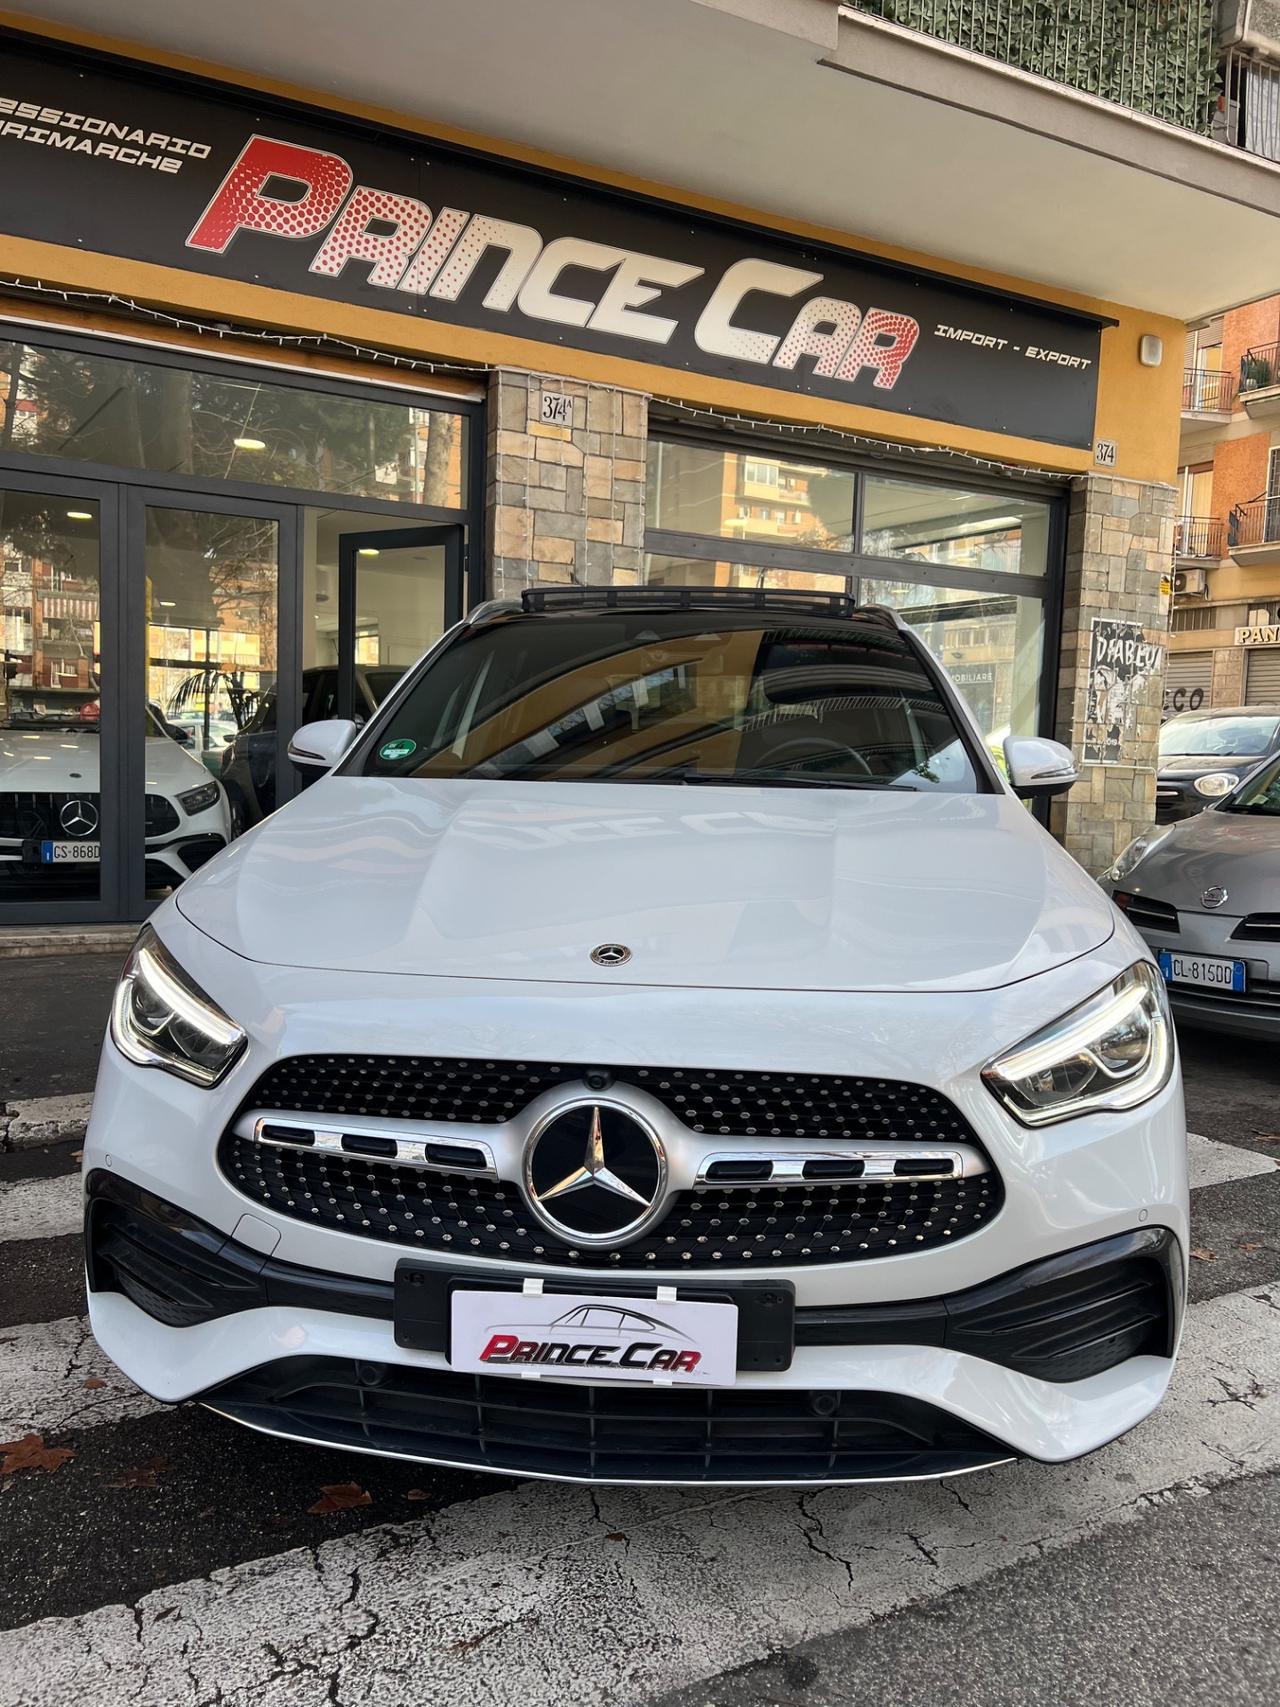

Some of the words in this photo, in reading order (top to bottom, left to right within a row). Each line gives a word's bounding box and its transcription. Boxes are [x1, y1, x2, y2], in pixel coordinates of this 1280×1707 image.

[0, 120, 183, 174] RIMARCHE
[185, 133, 705, 345] PRINCE
[695, 257, 920, 390] CAR
[934, 324, 1008, 350] IMPORT
[1025, 346, 1092, 370] EXPORT
[1097, 443, 1114, 463] 374
[479, 1334, 622, 1367] PRINCE
[618, 1342, 702, 1374] CAR
